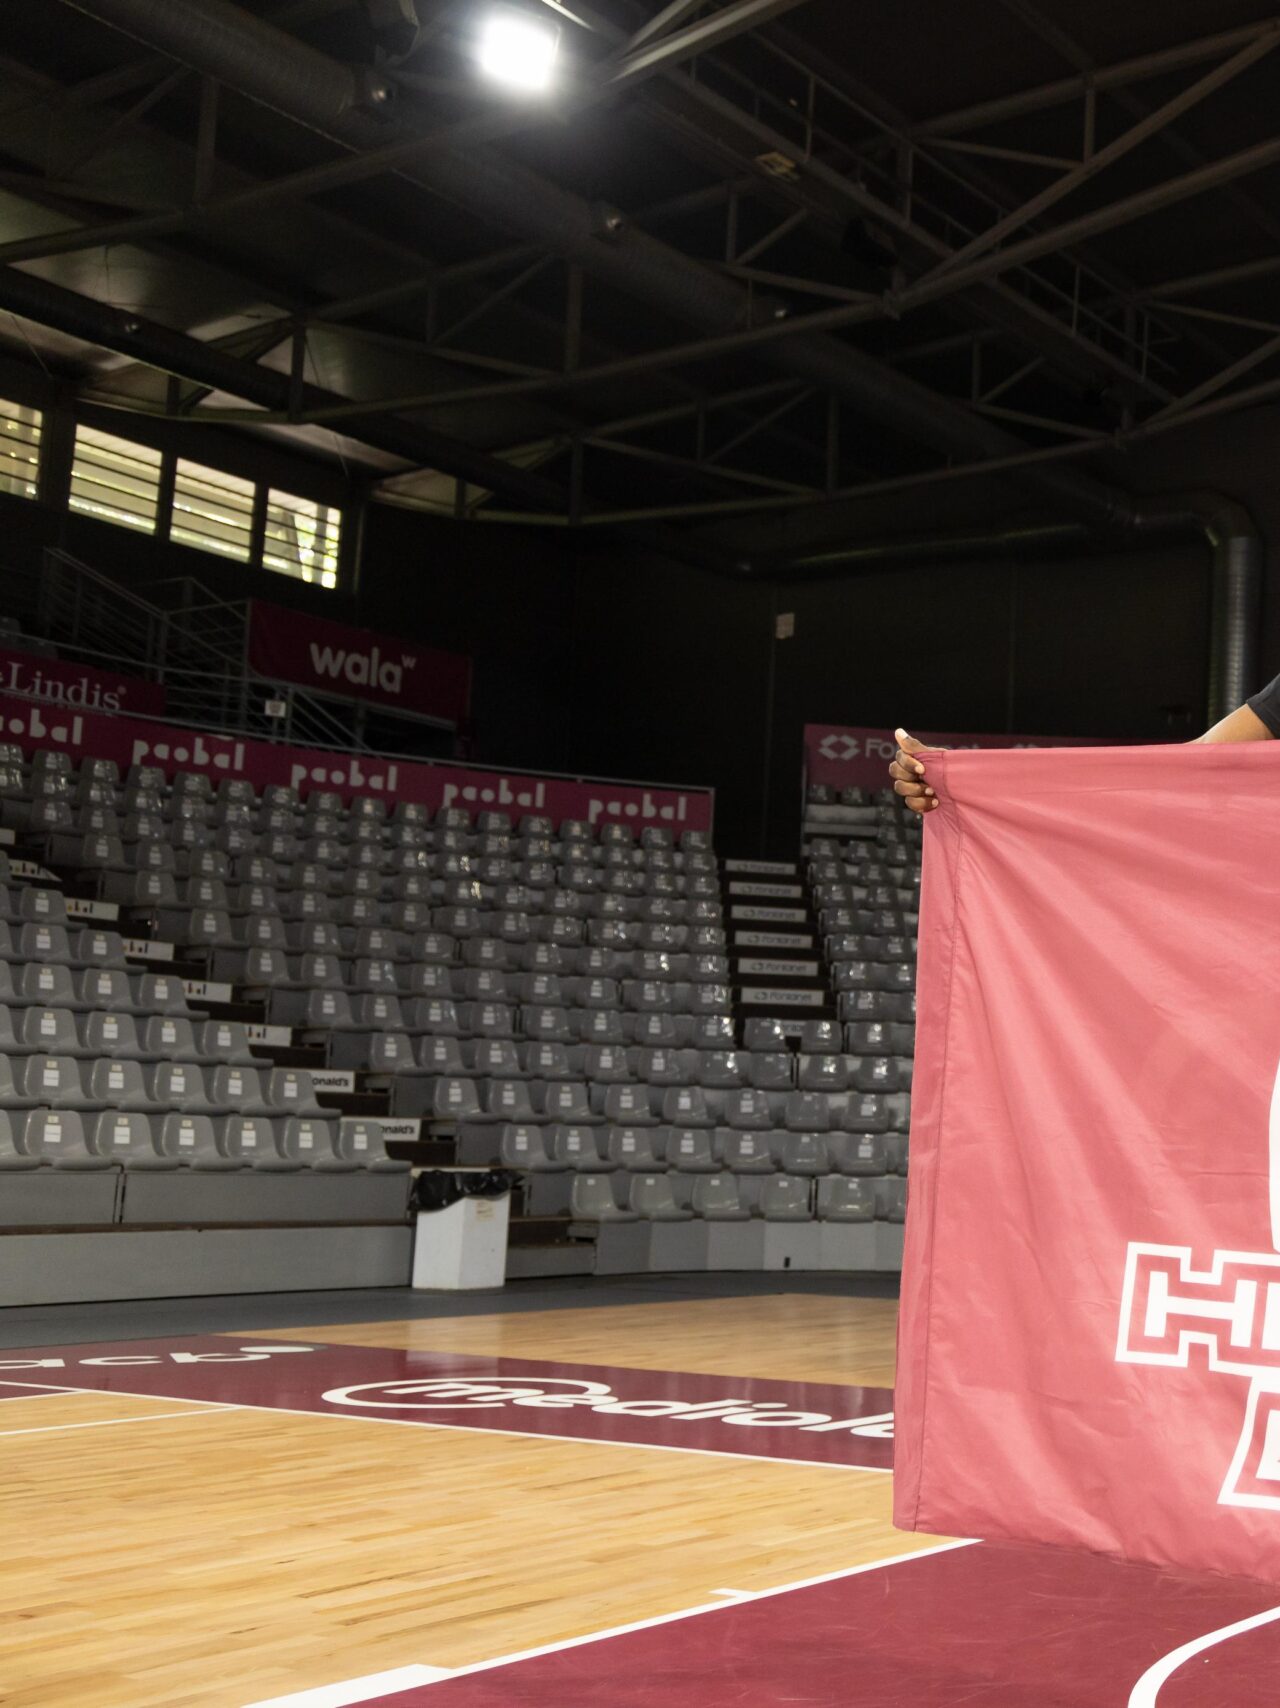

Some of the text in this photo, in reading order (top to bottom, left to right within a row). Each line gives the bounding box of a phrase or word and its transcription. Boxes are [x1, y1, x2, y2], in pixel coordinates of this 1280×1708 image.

[309, 642, 402, 694] wala
[0, 708, 83, 745] obal
[311, 1077, 349, 1087] onald's
